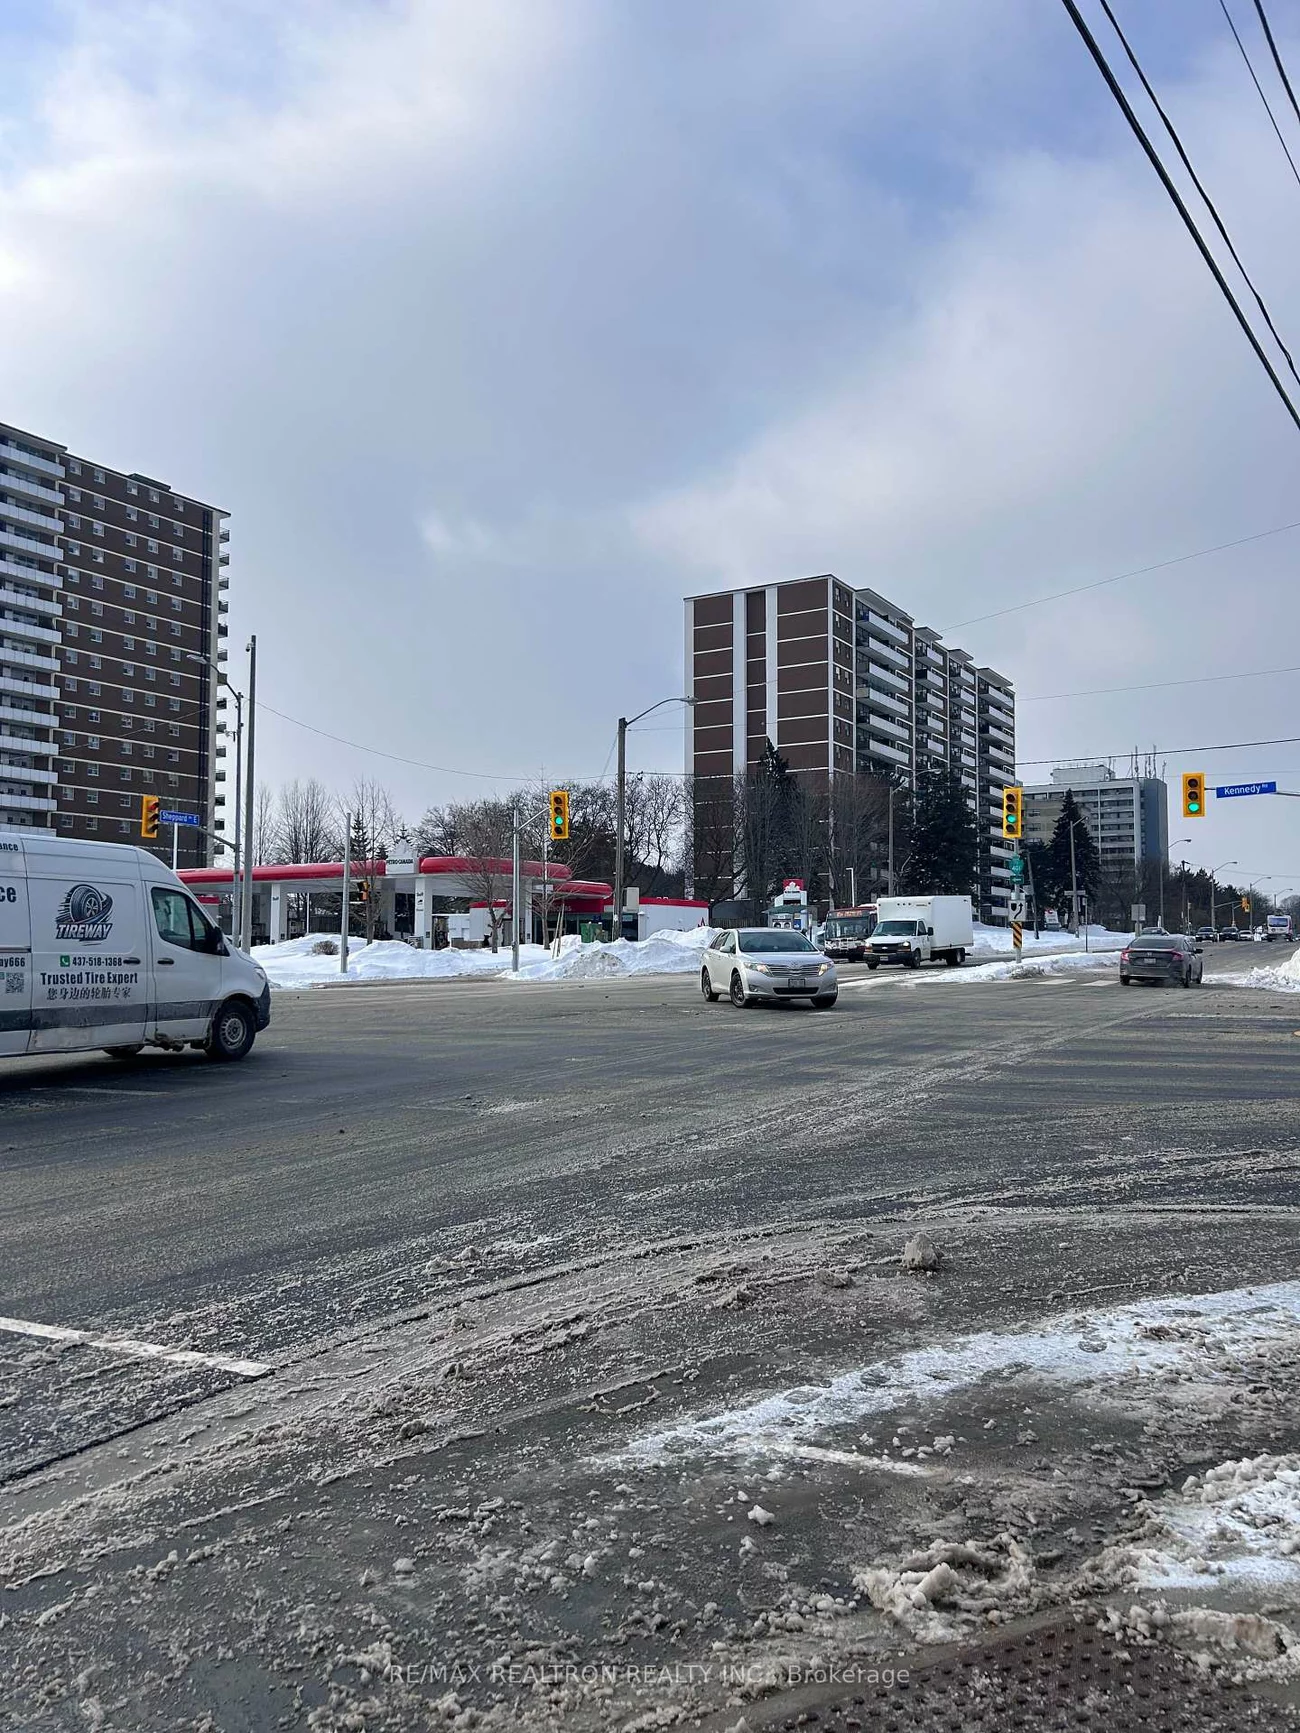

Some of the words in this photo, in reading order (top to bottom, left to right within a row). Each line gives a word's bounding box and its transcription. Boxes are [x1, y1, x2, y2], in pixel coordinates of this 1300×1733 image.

[1224, 784, 1261, 795] Kennedy
[162, 811, 187, 823] Sheppard
[193, 815, 198, 824] E
[56, 923, 112, 939] TIREWAY
[72, 956, 122, 967] 437-518-1368
[40, 972, 83, 985] Trusted
[85, 971, 105, 984] Tire
[107, 971, 138, 985] Expert
[46, 987, 131, 1001] 您身边的轮胎专家
